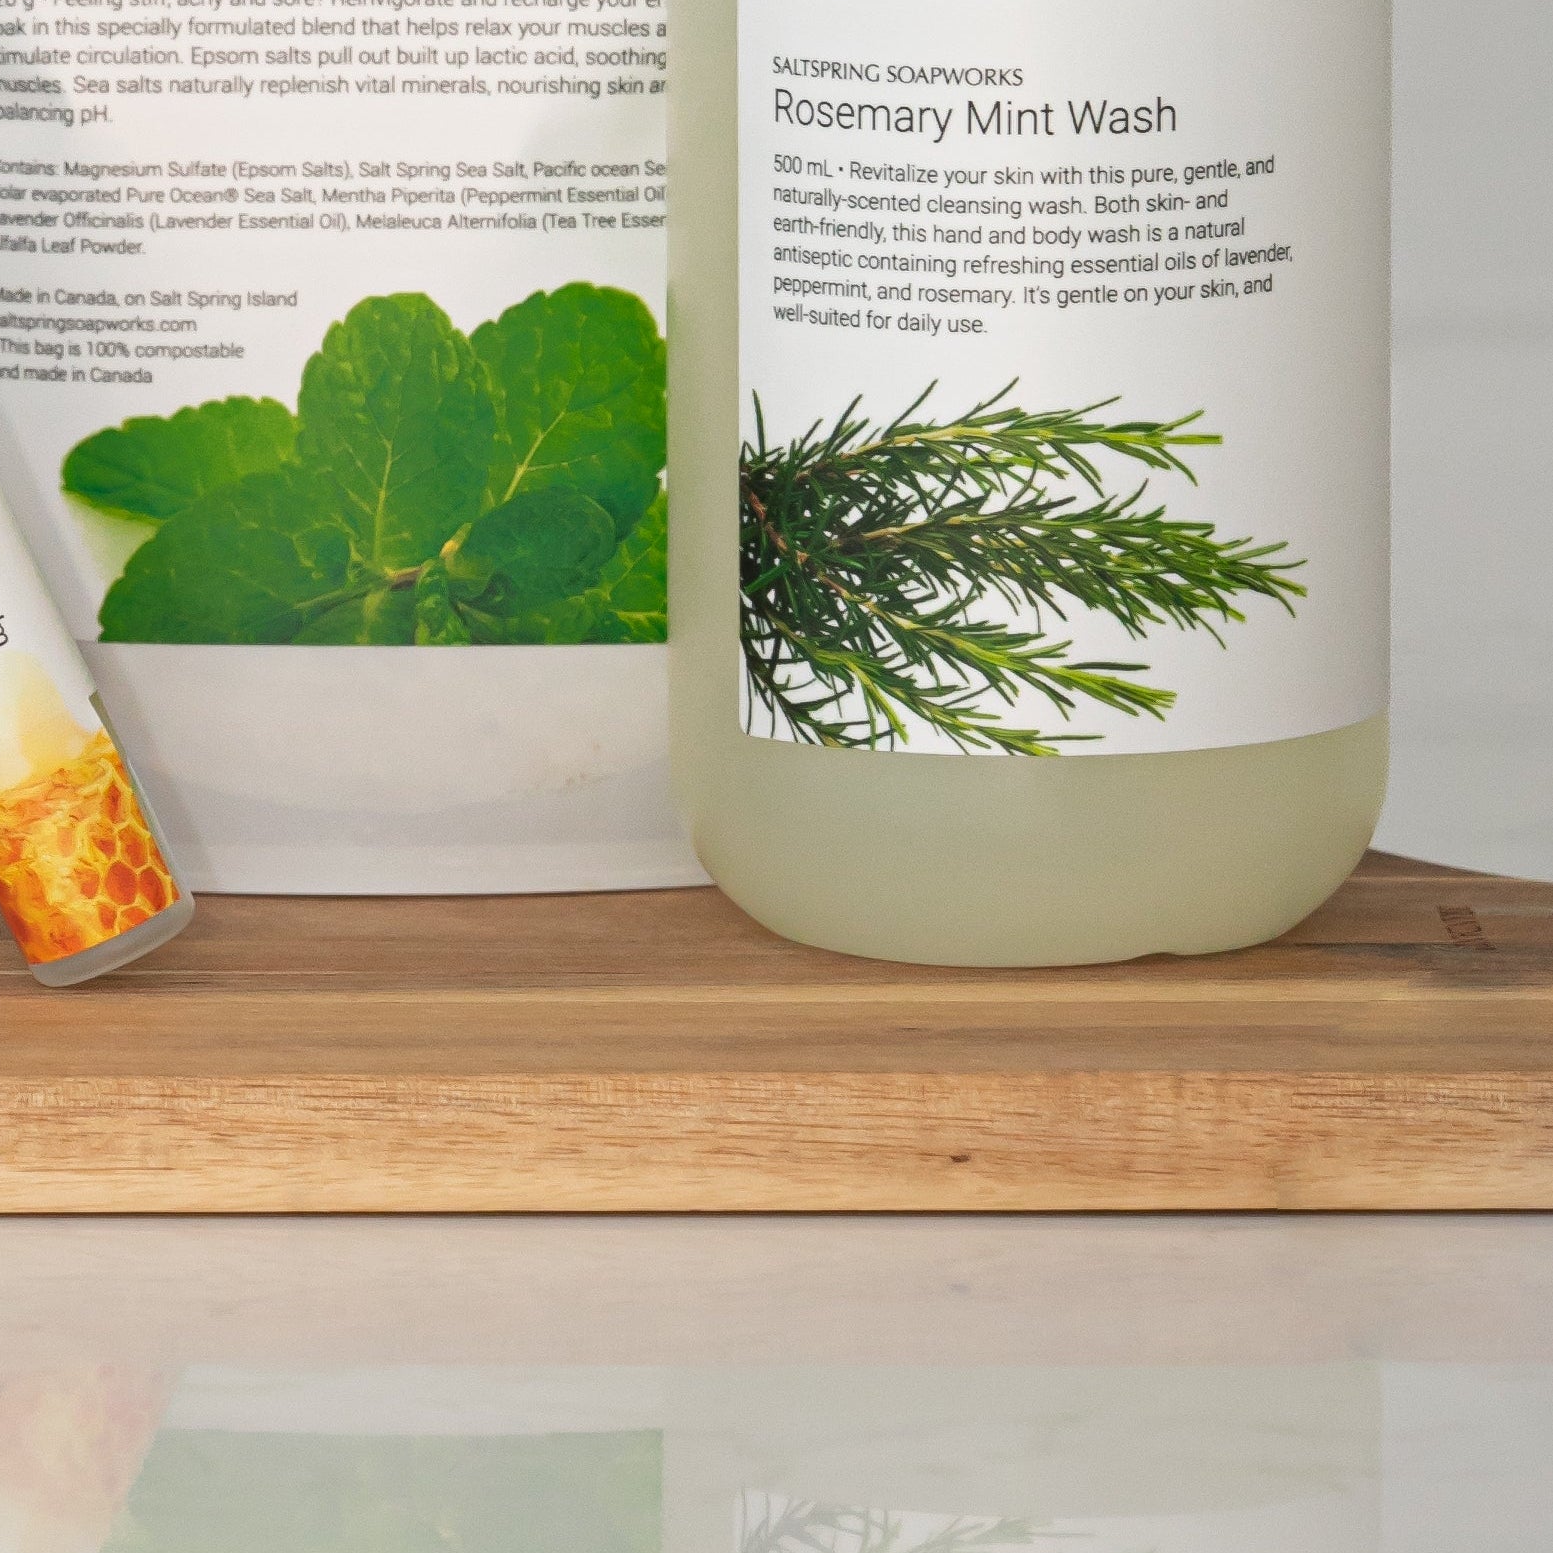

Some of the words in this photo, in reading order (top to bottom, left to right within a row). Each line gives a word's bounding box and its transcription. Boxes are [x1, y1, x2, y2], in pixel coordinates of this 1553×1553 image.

[772, 56, 879, 82] SALTSPRING
[886, 65, 1023, 86] SOAPWORKS
[775, 88, 952, 143] Rosemary
[967, 100, 1054, 135] Mint
[1067, 96, 1176, 134] Wash
[774, 153, 802, 174] 500
[807, 159, 833, 177] mL
[850, 161, 938, 183] Revitalize
[943, 170, 987, 188] your
[993, 166, 1033, 185] skin
[1040, 165, 1082, 184] with
[1088, 165, 1124, 184] this
[1131, 167, 1177, 187] pure,
[1183, 159, 1241, 185] gentle,
[1245, 154, 1274, 175] and
[773, 187, 920, 212] naturally-scented
[926, 194, 1021, 219] cleansing
[1028, 196, 1087, 214] wash.
[1094, 194, 1139, 213] Both
[1146, 193, 1190, 212] skin-
[1195, 188, 1228, 209] and
